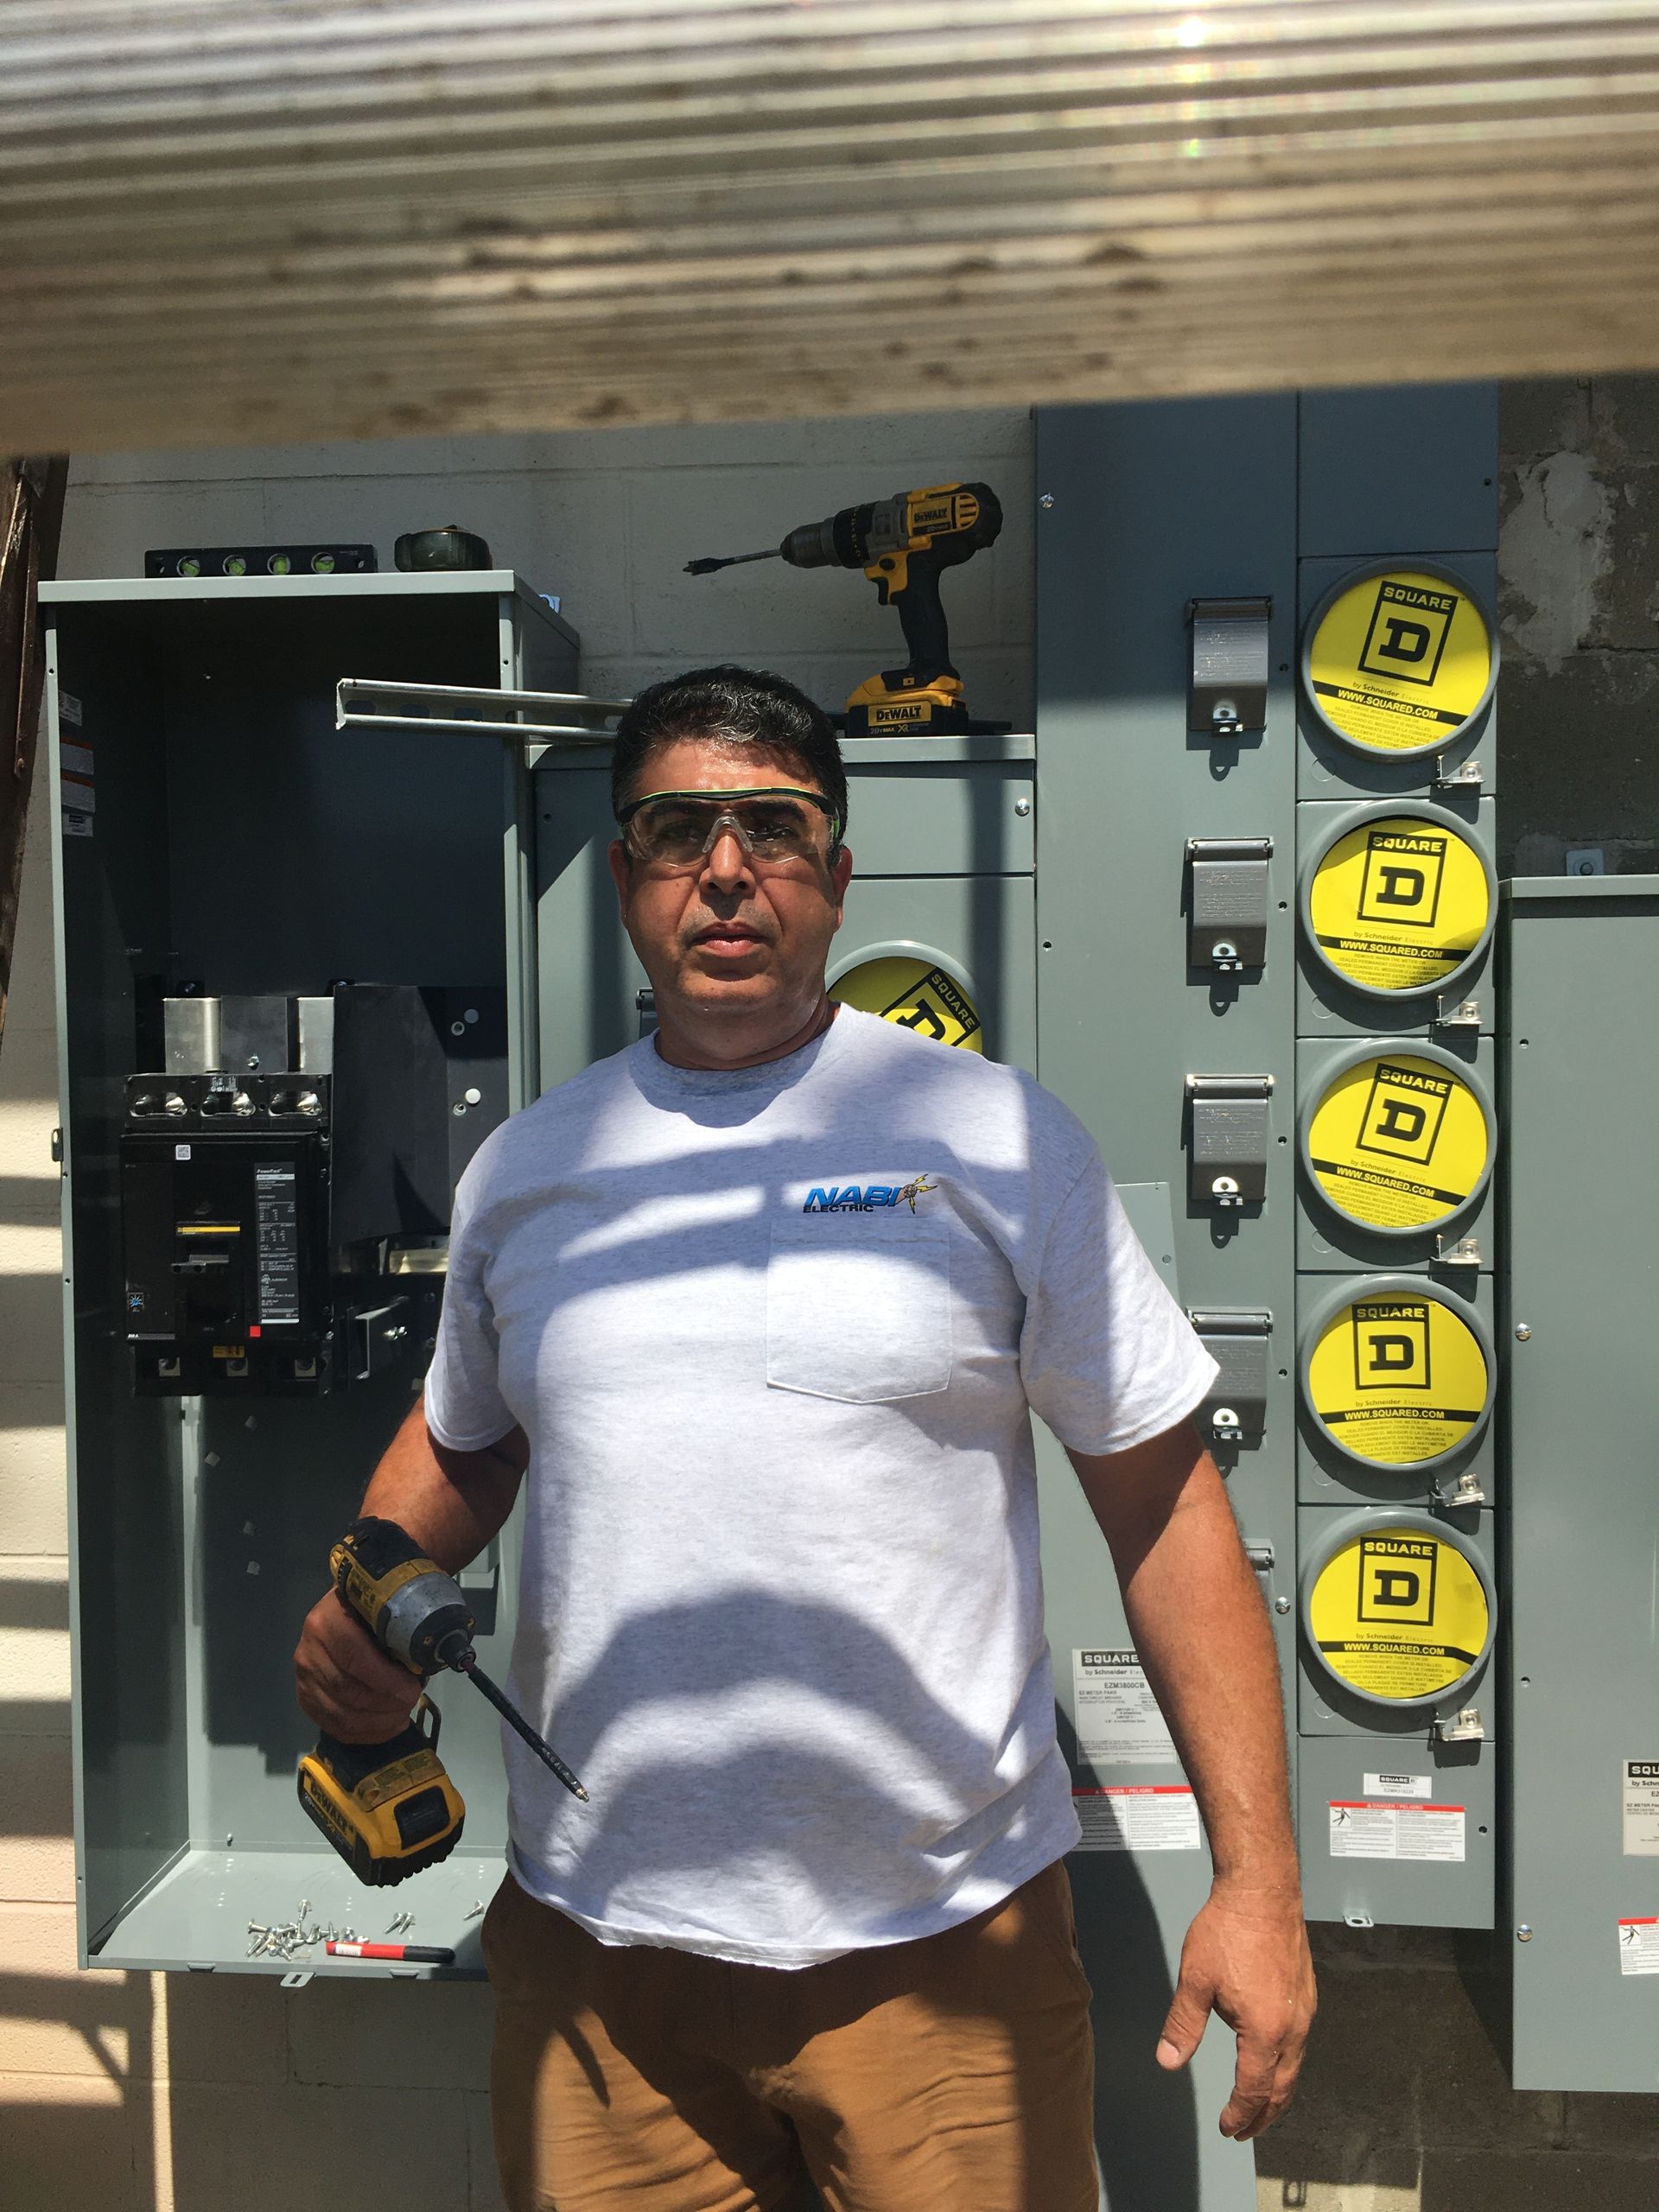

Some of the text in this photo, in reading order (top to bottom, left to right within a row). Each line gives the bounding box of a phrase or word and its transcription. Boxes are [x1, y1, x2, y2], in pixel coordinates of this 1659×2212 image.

[1384, 587, 1452, 610] SQUARE
[1378, 618, 1430, 662] D
[1363, 684, 1399, 697] Schneider
[877, 705, 921, 721] DEWALT
[1338, 689, 1438, 719] WWW.SQUARED.COM
[1373, 837, 1442, 852] SQUARE
[1376, 866, 1424, 906] D
[1364, 932, 1402, 942] Schneider
[1340, 940, 1442, 958] WWW.SQUARED.COM
[931, 974, 975, 1029] SQUARE
[1380, 1069, 1448, 1094] SQUARE
[1375, 1098, 1426, 1142] D
[1360, 1161, 1396, 1174] Schneider
[1337, 1167, 1434, 1197] WWW.SQUARED.COM
[804, 1186, 901, 1206] NABI
[803, 1204, 873, 1213] ELECTRIC
[1357, 1308, 1424, 1318] SQUARE
[1369, 1335, 1414, 1370] D
[1345, 1410, 1444, 1420] WWW.SQUARED.COM
[1364, 1542, 1432, 1555] SQUARE
[1374, 1569, 1419, 1606] D
[1344, 1643, 1444, 1655] WWW.SQUARED.COM
[1085, 1655, 1139, 1663] SQUARE
